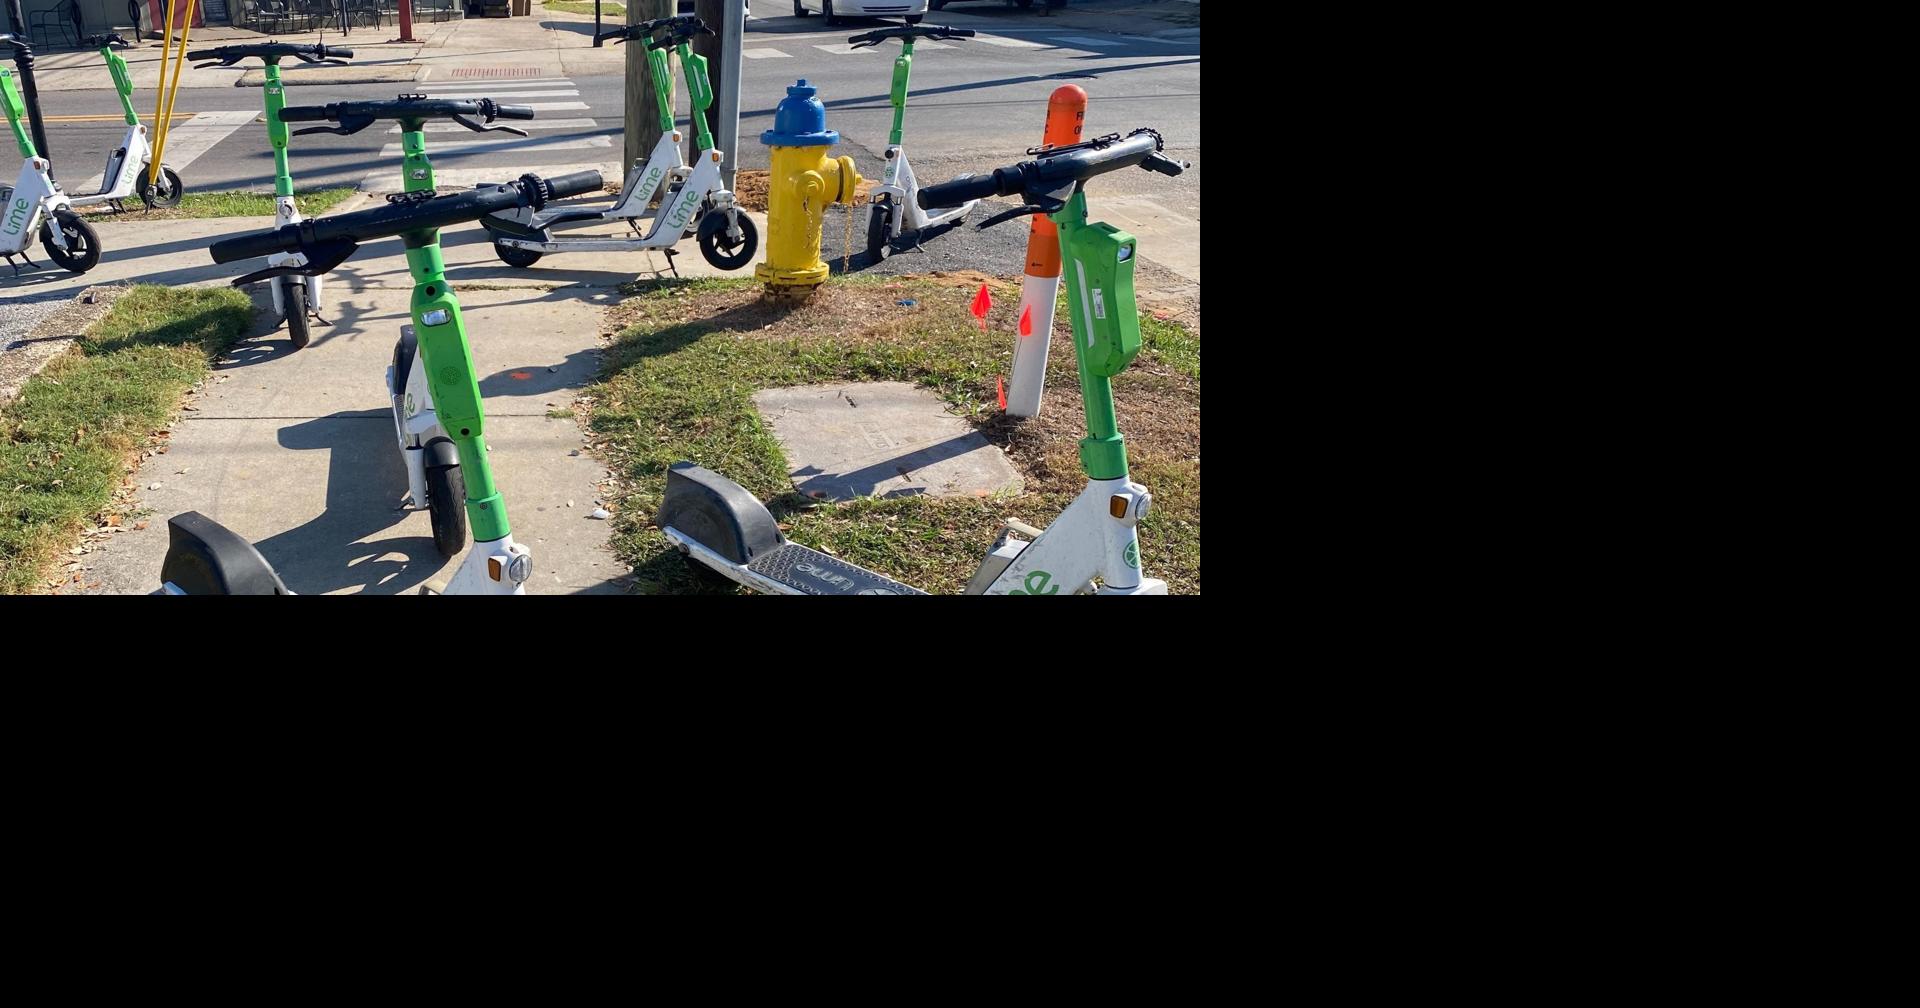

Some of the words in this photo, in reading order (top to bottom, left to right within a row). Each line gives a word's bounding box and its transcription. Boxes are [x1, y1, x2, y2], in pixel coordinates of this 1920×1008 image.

[122, 155, 140, 185] Lime
[634, 167, 662, 201] Lime
[2, 198, 30, 236] Lime
[667, 190, 700, 230] Lime
